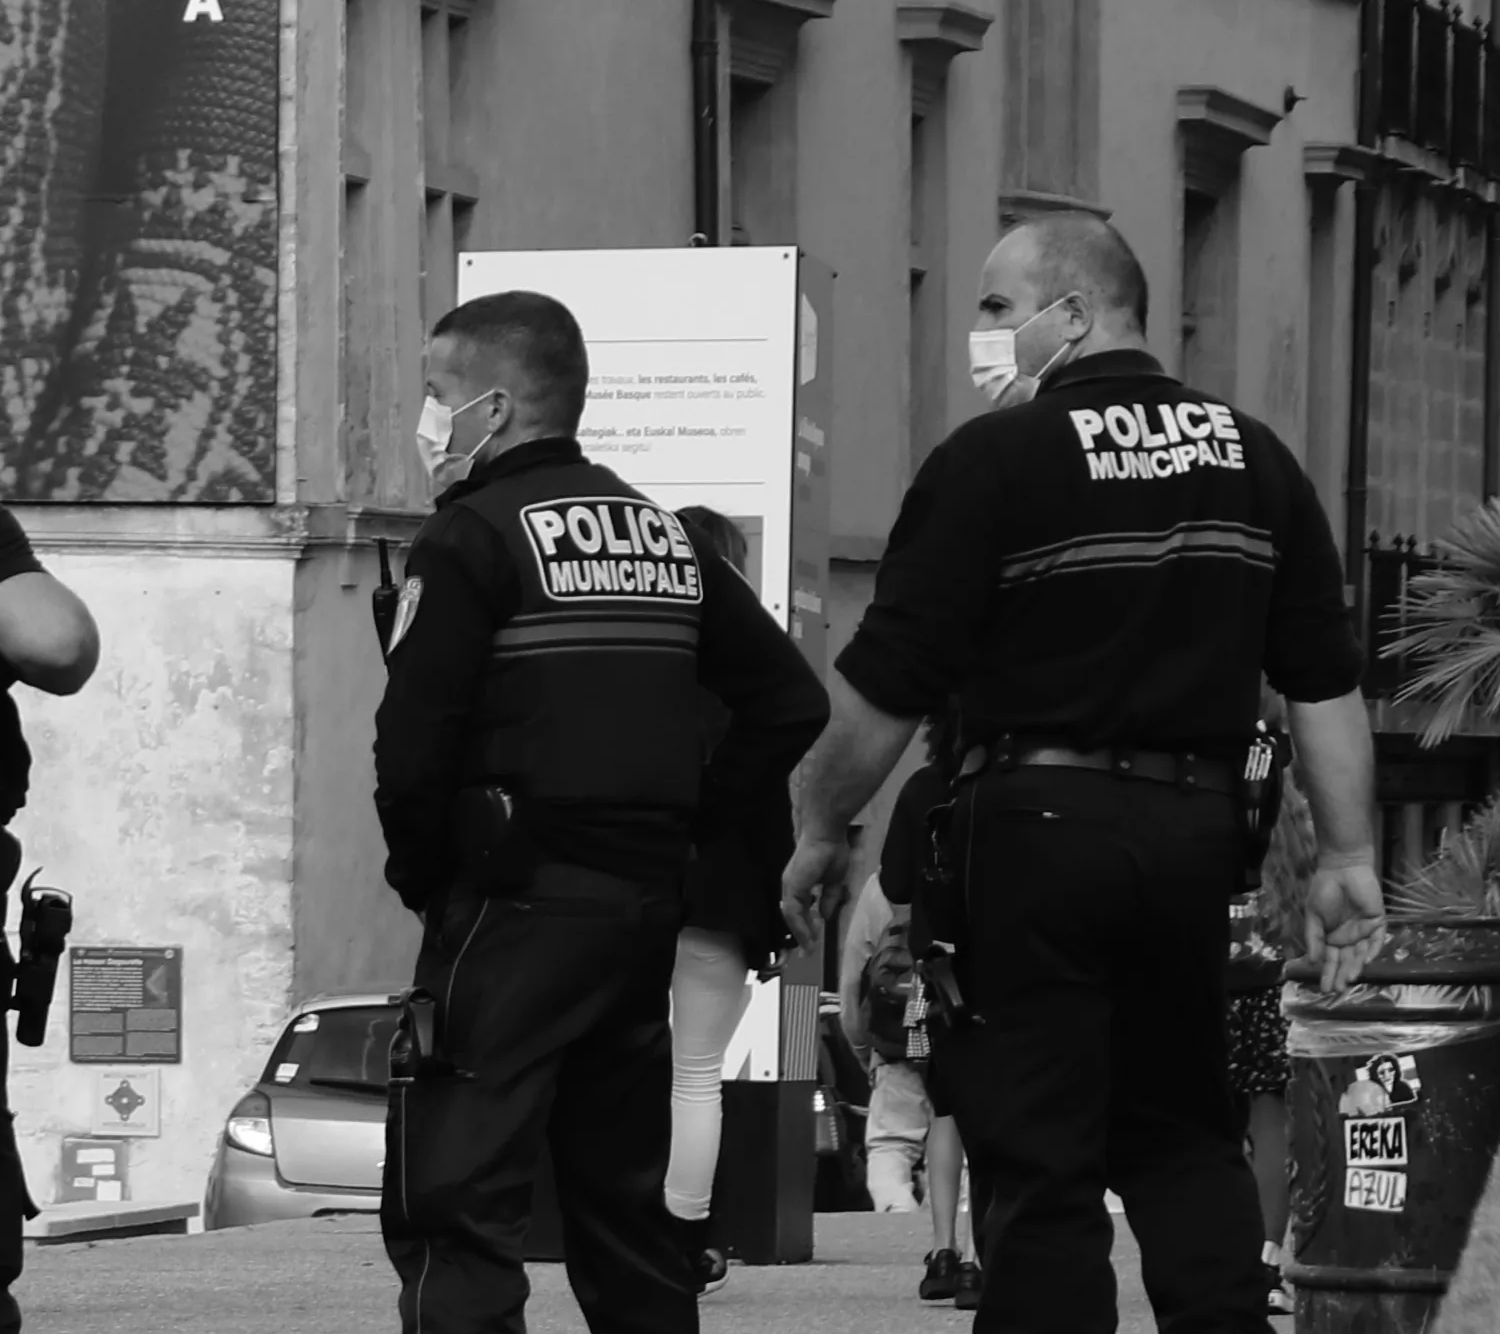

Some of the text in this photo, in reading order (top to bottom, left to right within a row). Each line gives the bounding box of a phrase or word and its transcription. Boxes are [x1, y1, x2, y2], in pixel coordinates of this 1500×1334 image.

[1069, 402, 1240, 450] POLICE
[1086, 439, 1246, 480] MUNICIPALE
[528, 504, 693, 558] POLICE
[549, 560, 698, 596] MUNICIPALE
[1347, 1170, 1405, 1210] AZUL
